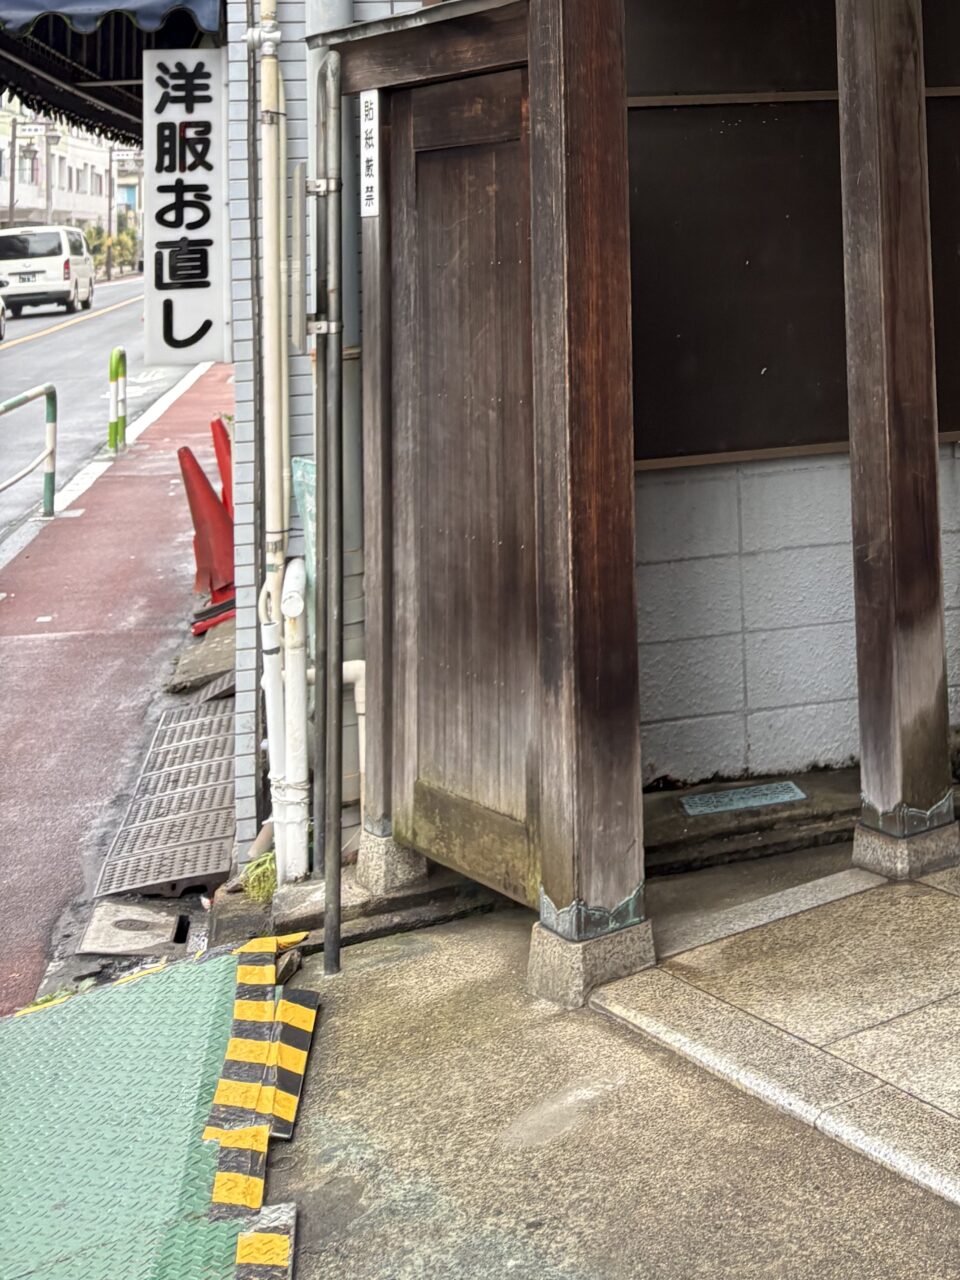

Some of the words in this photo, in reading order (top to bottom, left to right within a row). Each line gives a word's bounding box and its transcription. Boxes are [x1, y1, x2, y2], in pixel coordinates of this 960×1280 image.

[154, 61, 214, 350] 洋服お直し
